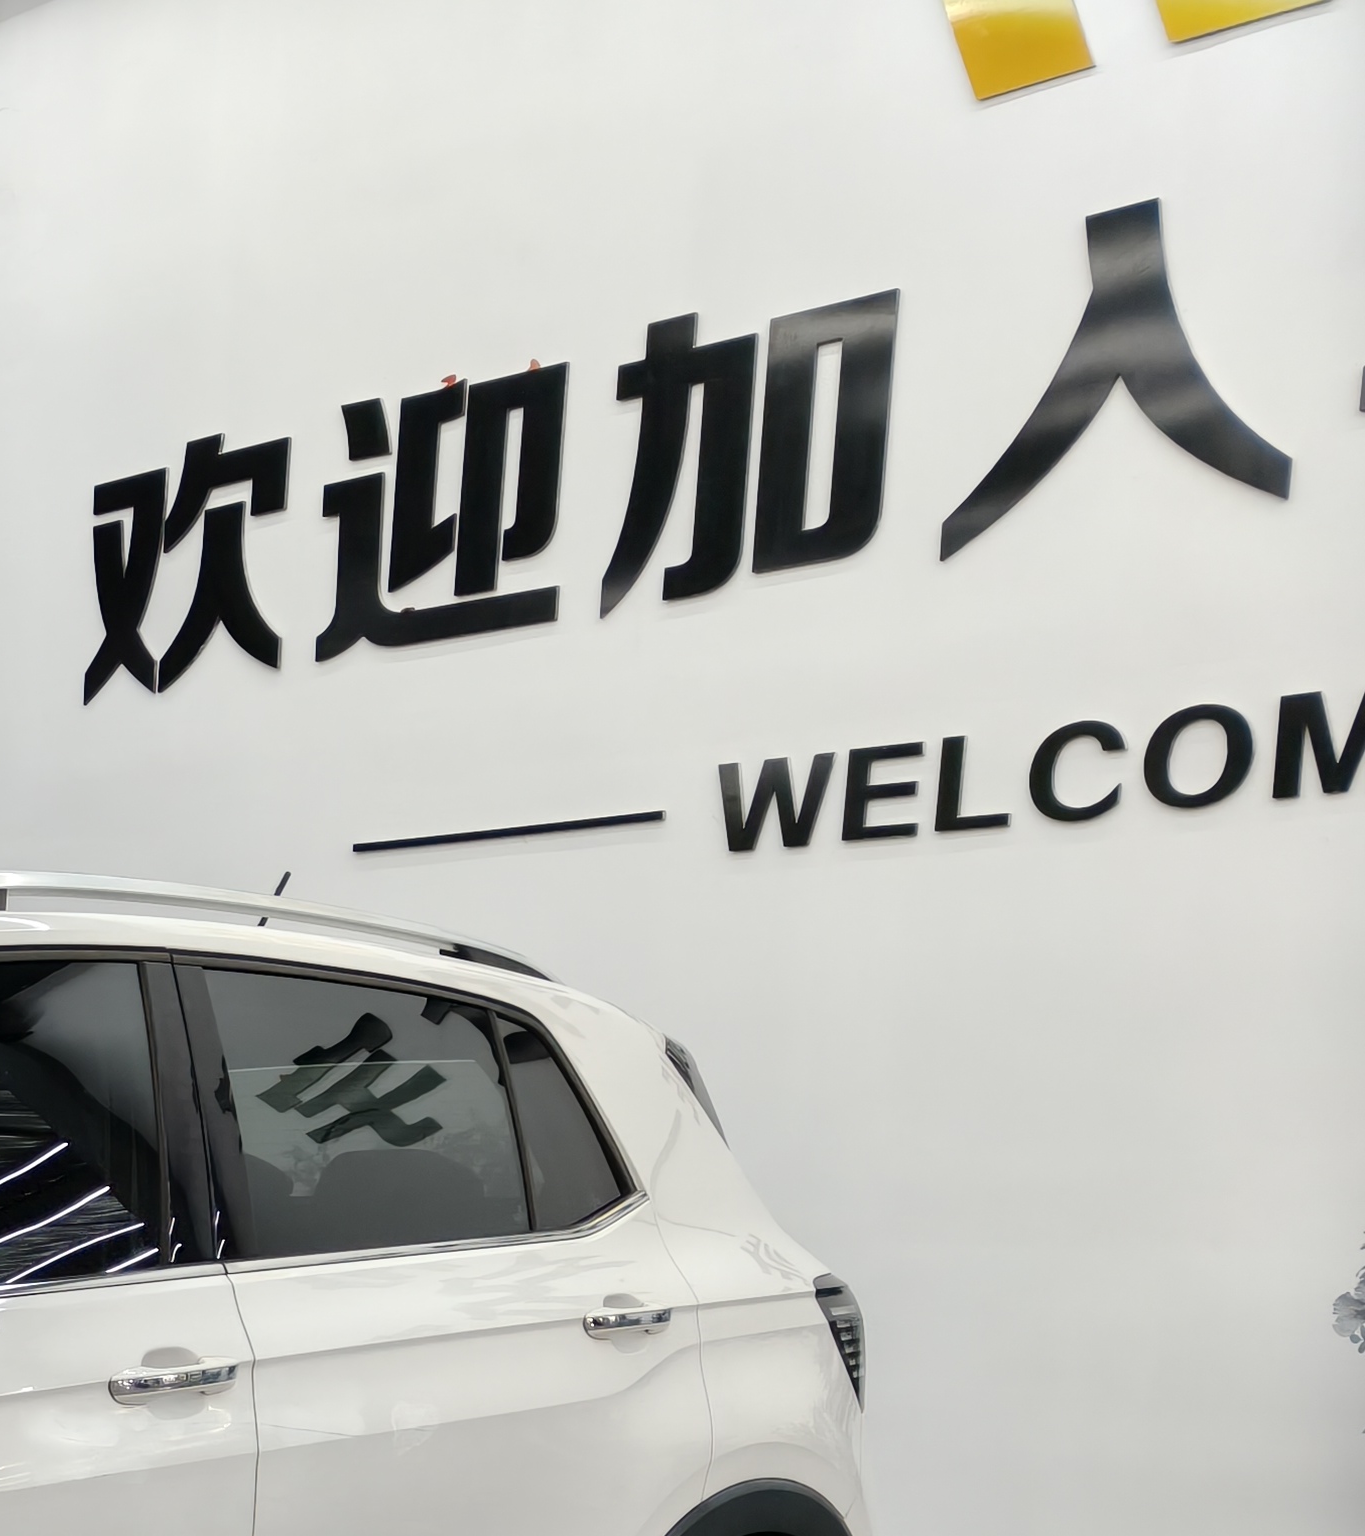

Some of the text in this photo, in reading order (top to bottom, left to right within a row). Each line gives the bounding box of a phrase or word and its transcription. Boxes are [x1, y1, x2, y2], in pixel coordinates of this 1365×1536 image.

[83, 197, 1365, 705] 欢迎加入
[717, 690, 1365, 854] WELCOM
